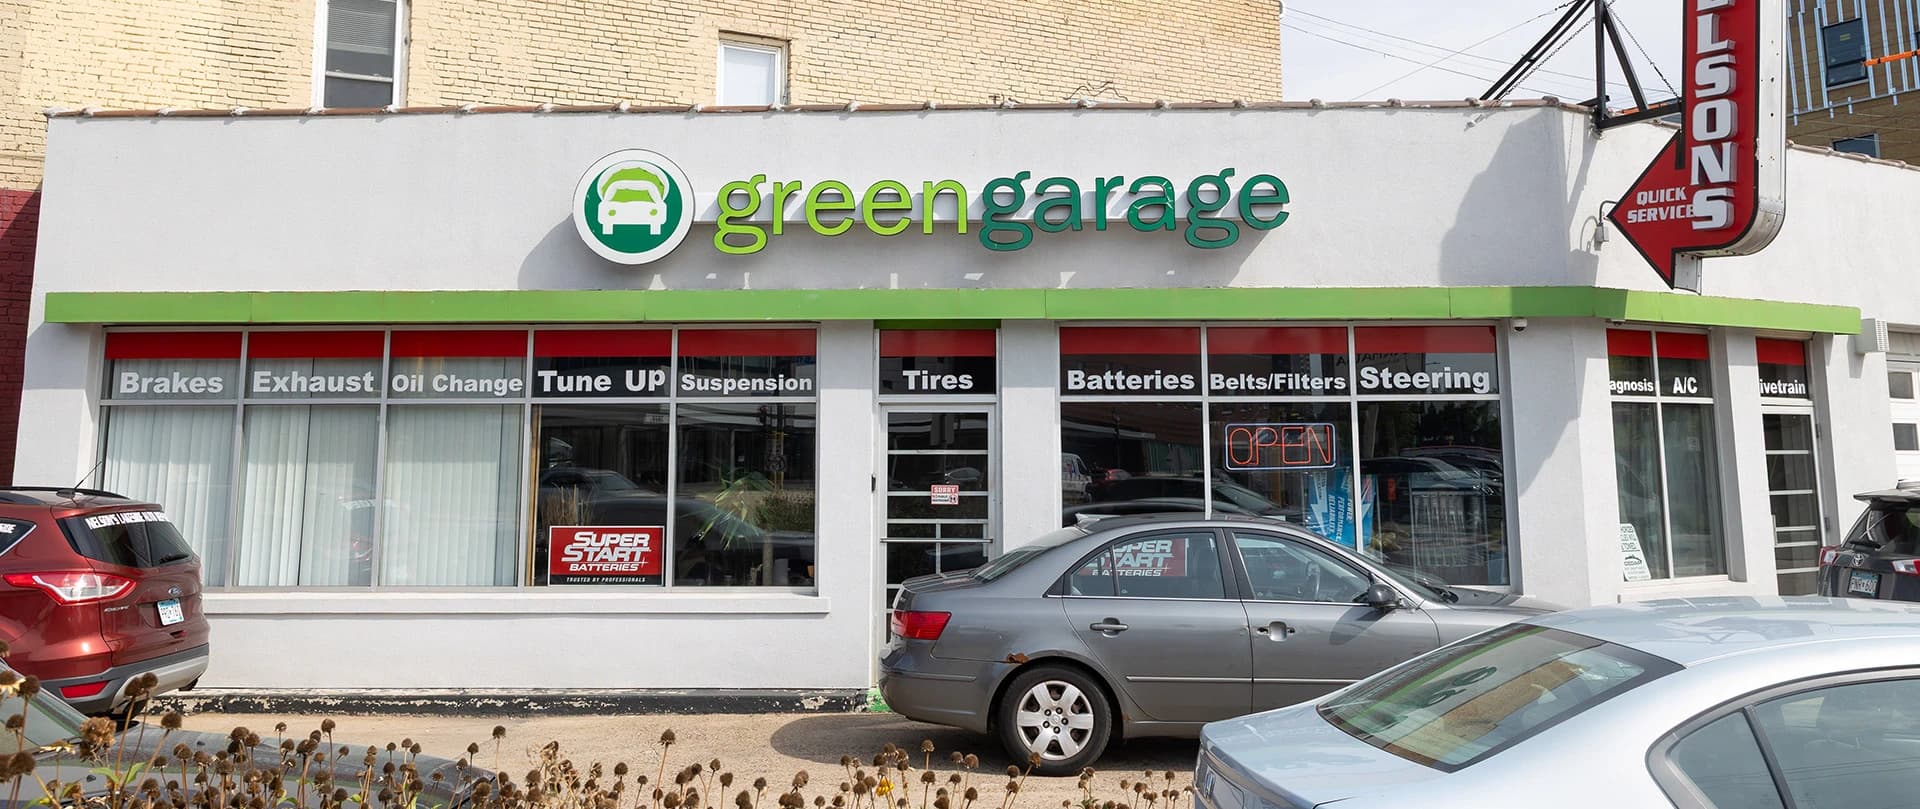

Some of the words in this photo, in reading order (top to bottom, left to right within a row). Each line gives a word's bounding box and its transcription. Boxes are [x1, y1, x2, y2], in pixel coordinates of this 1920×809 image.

[1691, 0, 1737, 230] LSONS
[1637, 186, 1687, 206] QUICK
[1627, 204, 1696, 224] SERVICE
[119, 371, 224, 394] Brakes
[252, 370, 375, 393] Exhaust
[391, 374, 424, 392] Oil
[432, 374, 523, 396] Change
[537, 370, 612, 392] Tune
[681, 374, 812, 394] Suspension
[903, 370, 973, 390] Tires
[1067, 370, 1195, 390] Batteries
[1210, 373, 1347, 391] Belts/Filters
[1360, 366, 1490, 394] Steering
[1673, 376, 1698, 394] A/C
[1228, 424, 1332, 466] OPEN
[571, 531, 650, 547] SUPER
[561, 544, 652, 562] START
[569, 563, 640, 572] BATTERIES
